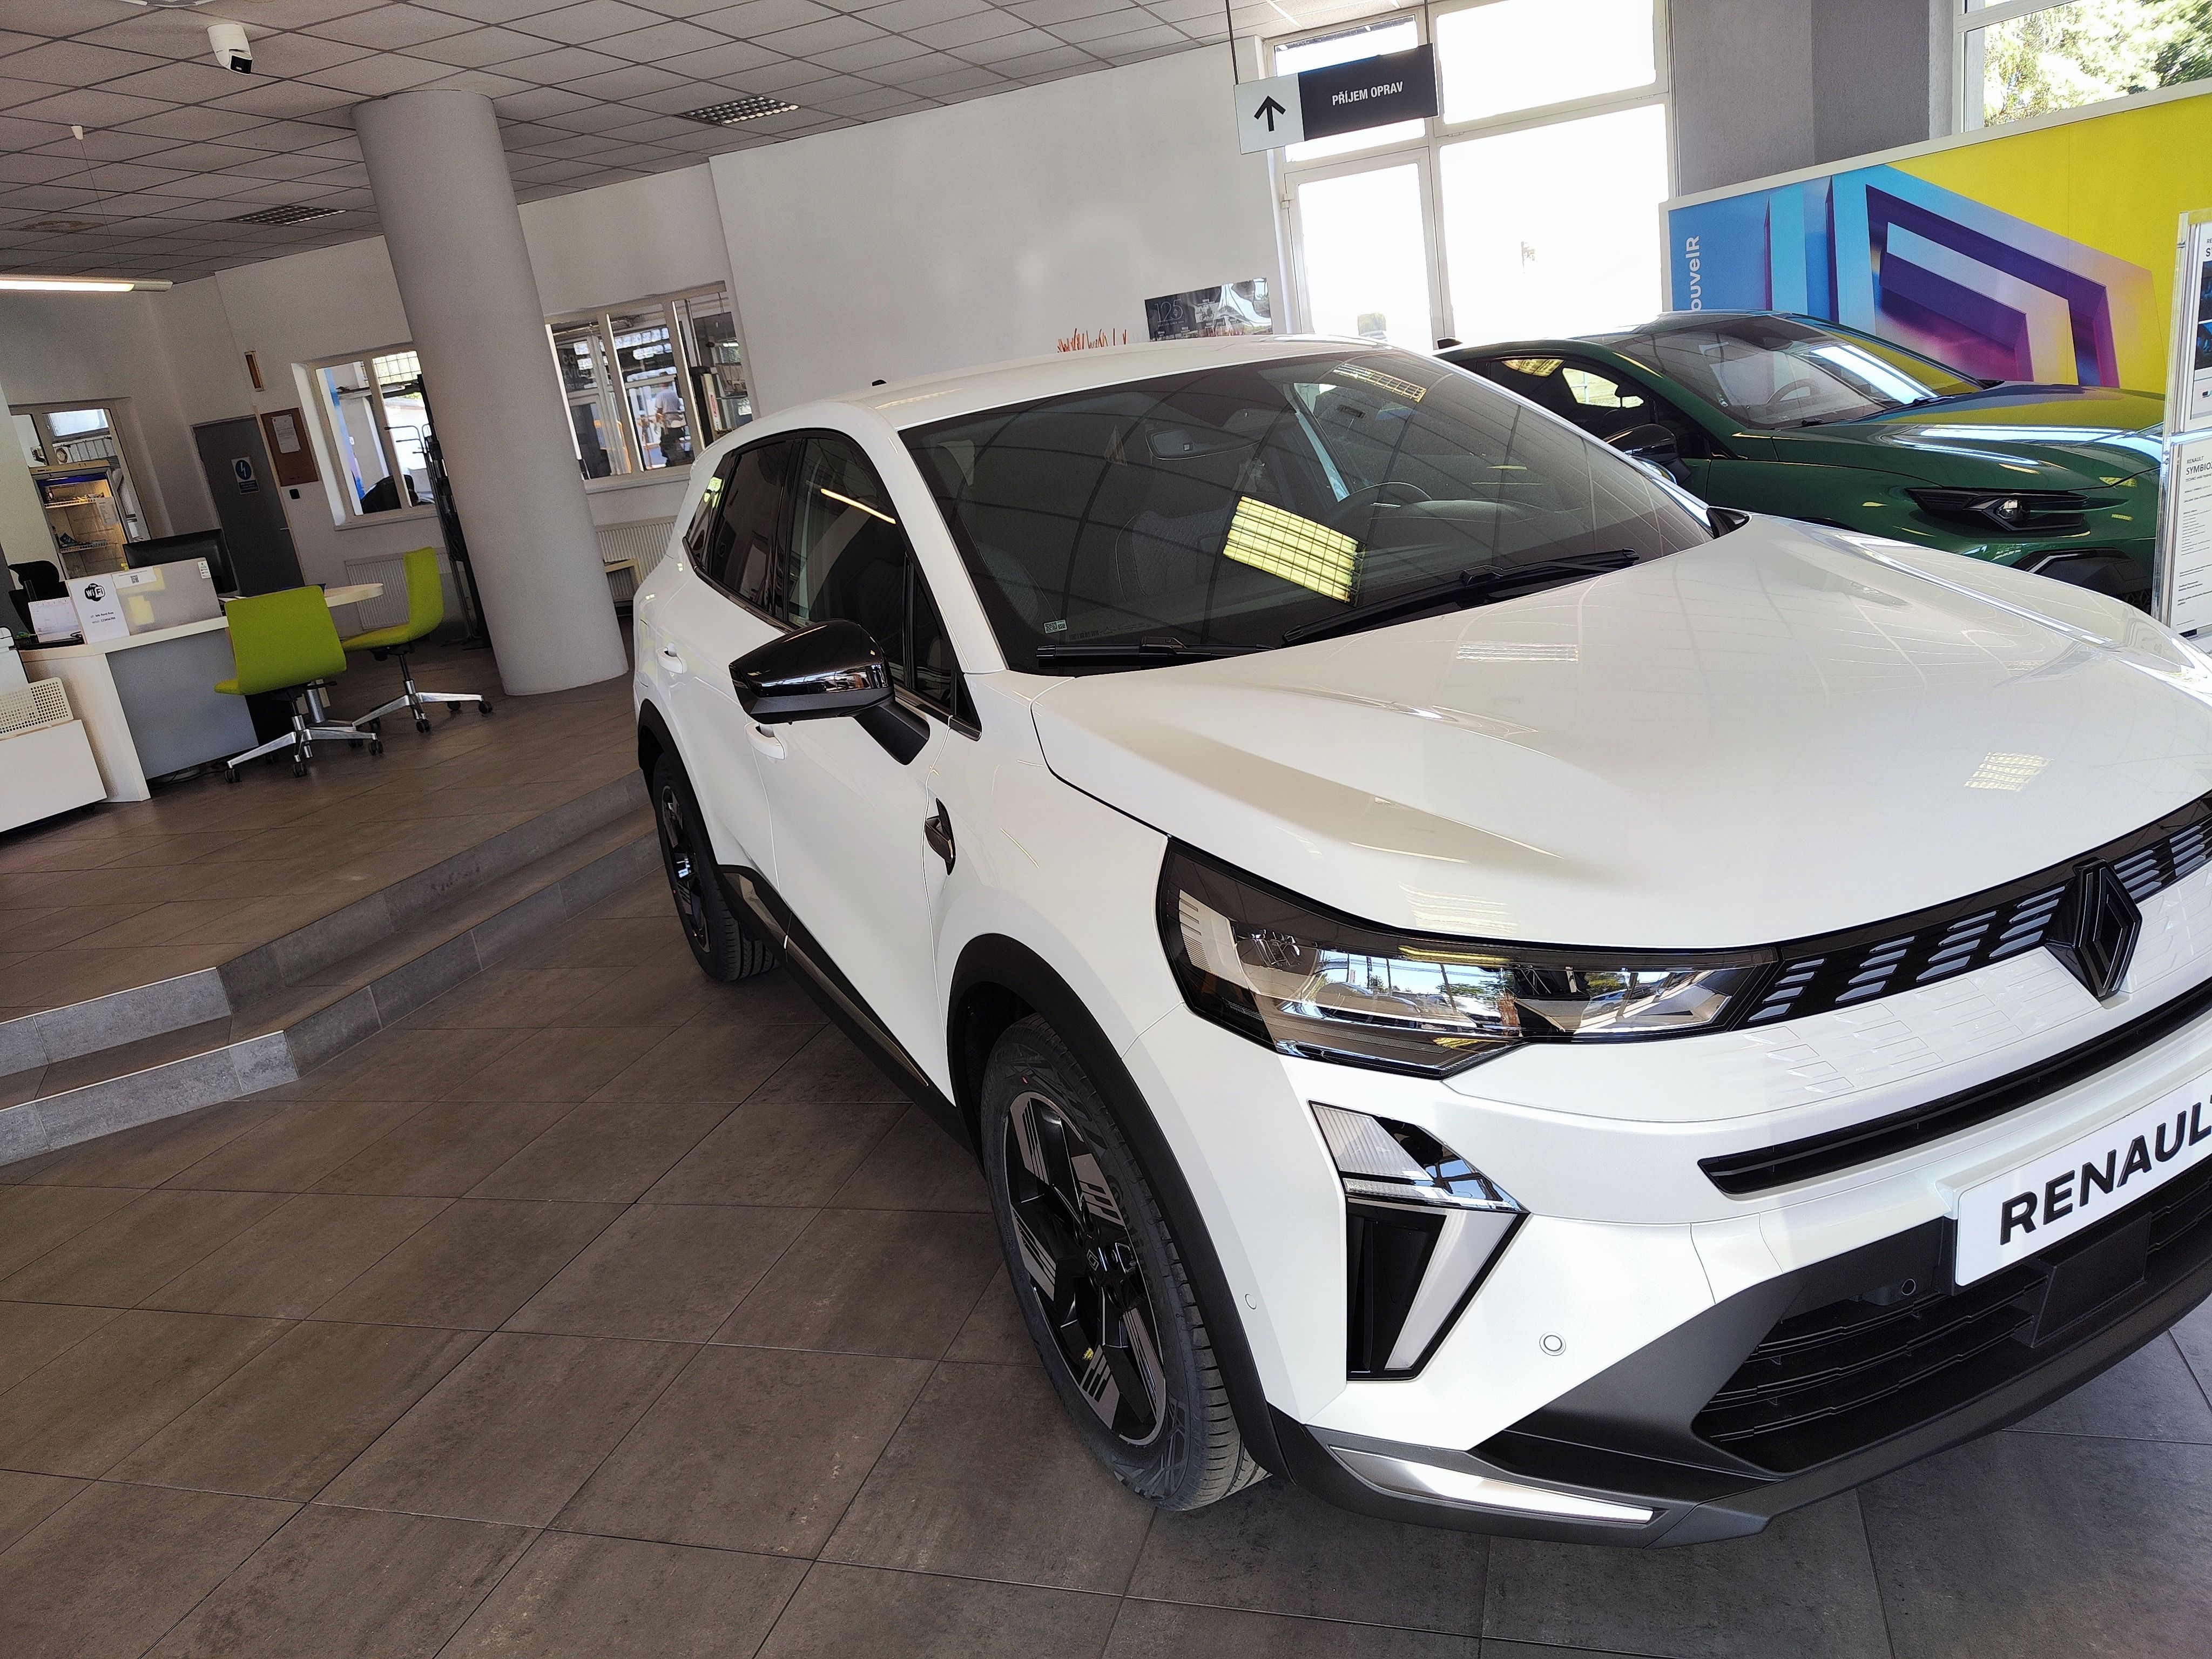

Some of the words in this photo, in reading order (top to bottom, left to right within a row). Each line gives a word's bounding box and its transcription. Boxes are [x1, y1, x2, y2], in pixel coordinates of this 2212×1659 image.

[1332, 90, 1368, 106] PŘÍJEM
[1371, 81, 1403, 98] OPRAV
[1685, 235, 1702, 311] ouvelR
[1155, 299, 1183, 322] 125
[2187, 455, 2204, 464] RENAULT
[2000, 1094, 2212, 1246] RENAUL
